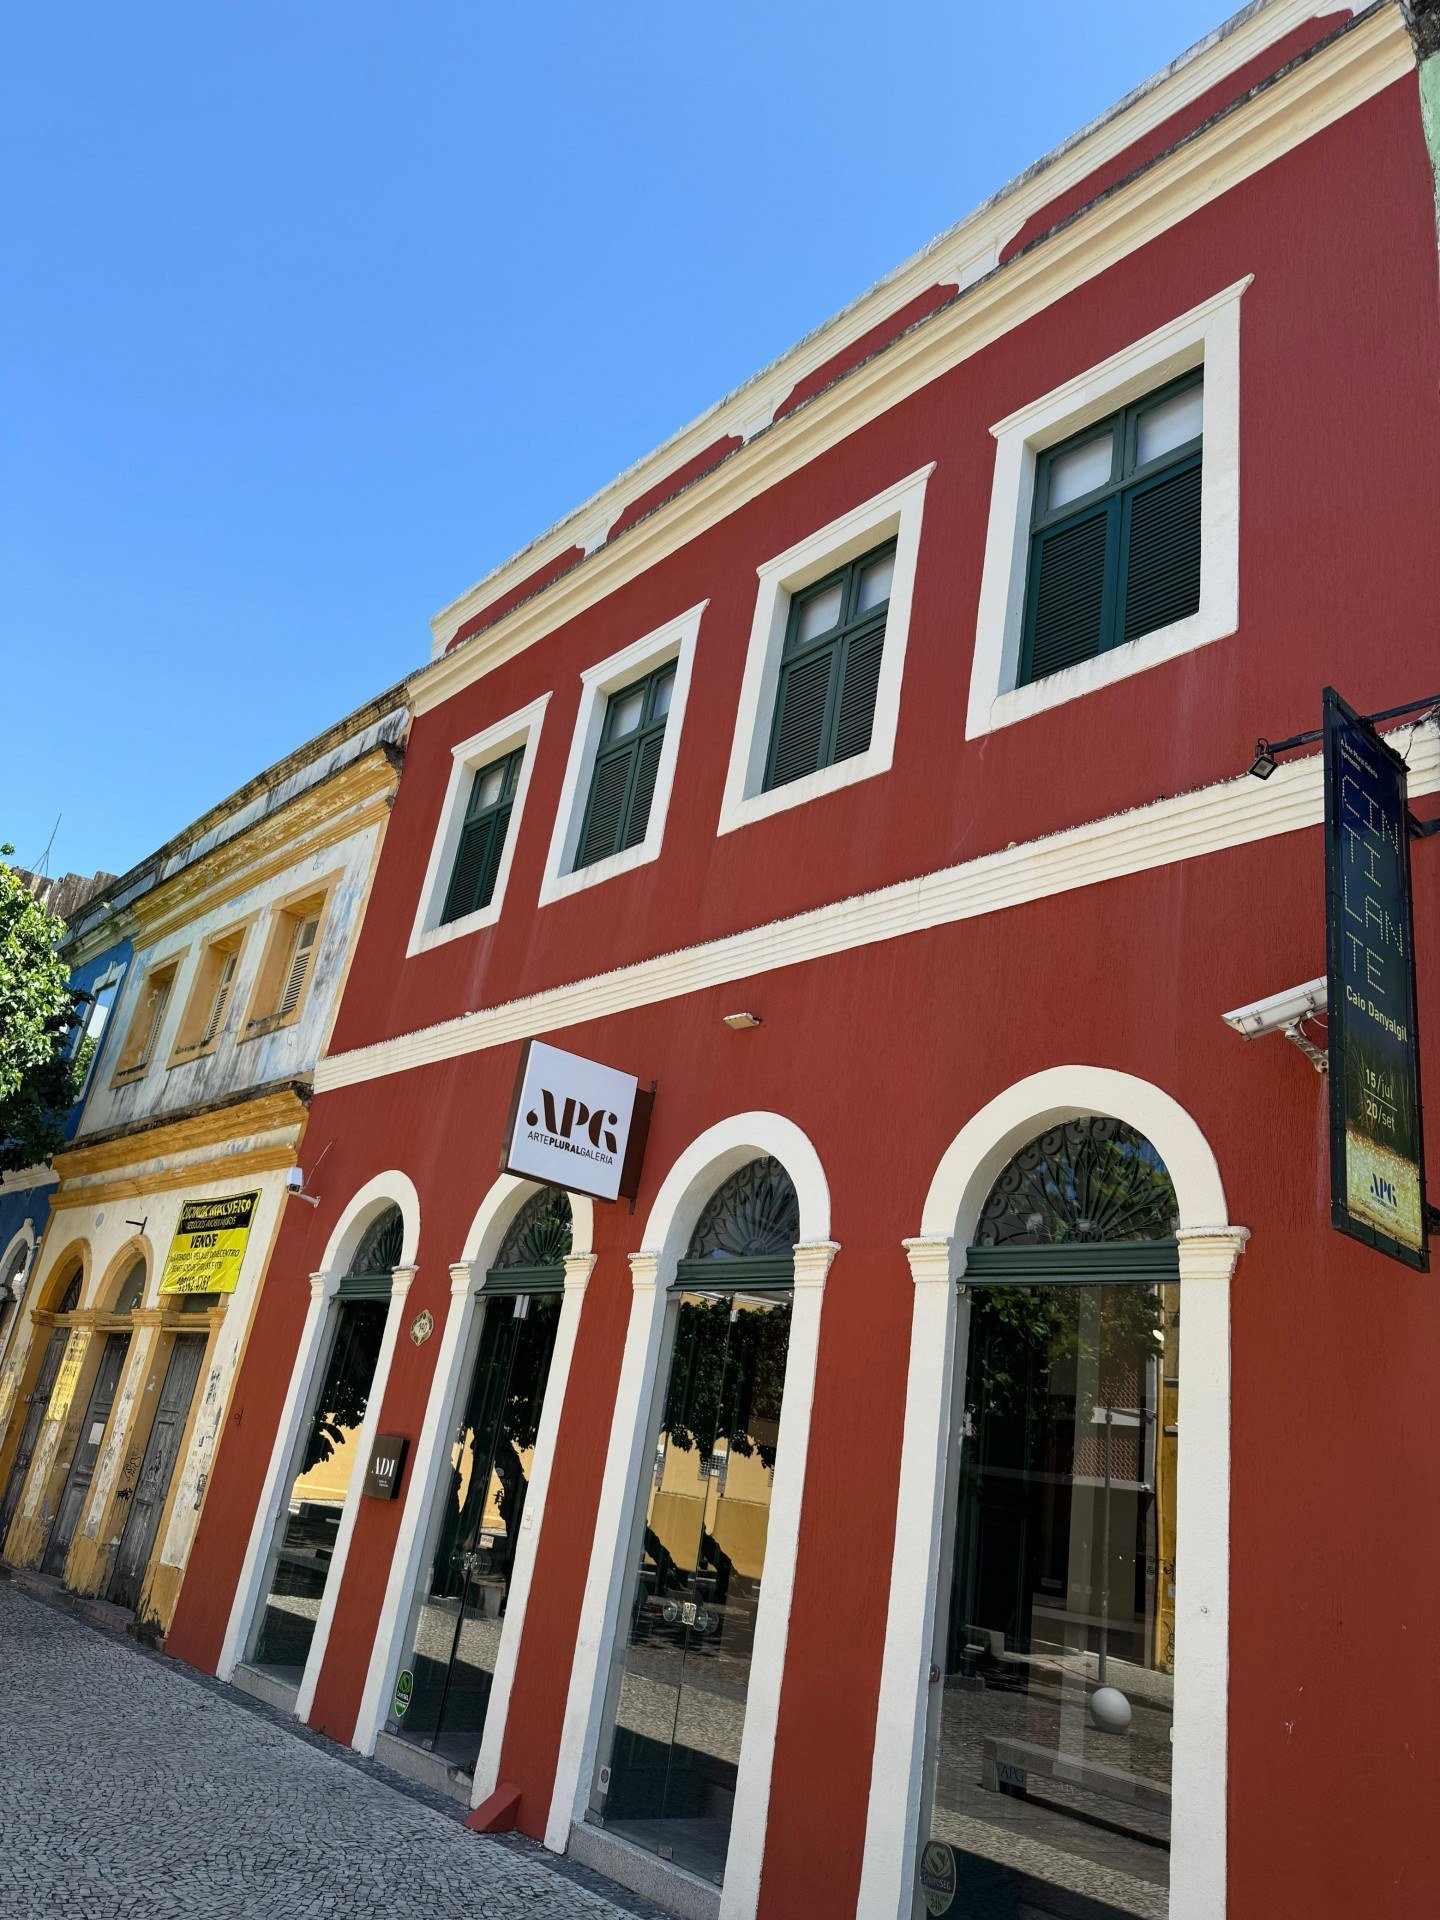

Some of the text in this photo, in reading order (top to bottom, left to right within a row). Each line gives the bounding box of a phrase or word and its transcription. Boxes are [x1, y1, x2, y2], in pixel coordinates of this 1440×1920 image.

[1346, 984, 1408, 1042] Caio Danyalgil
[1365, 1068, 1394, 1101] 15/jul
[526, 1088, 618, 1154] APG
[1366, 1099, 1396, 1132] 20/set
[1369, 1172, 1398, 1208] APG
[190, 1233, 219, 1249] VENDE
[371, 1456, 395, 1477] ADI
[1001, 1765, 1024, 1783] APG
